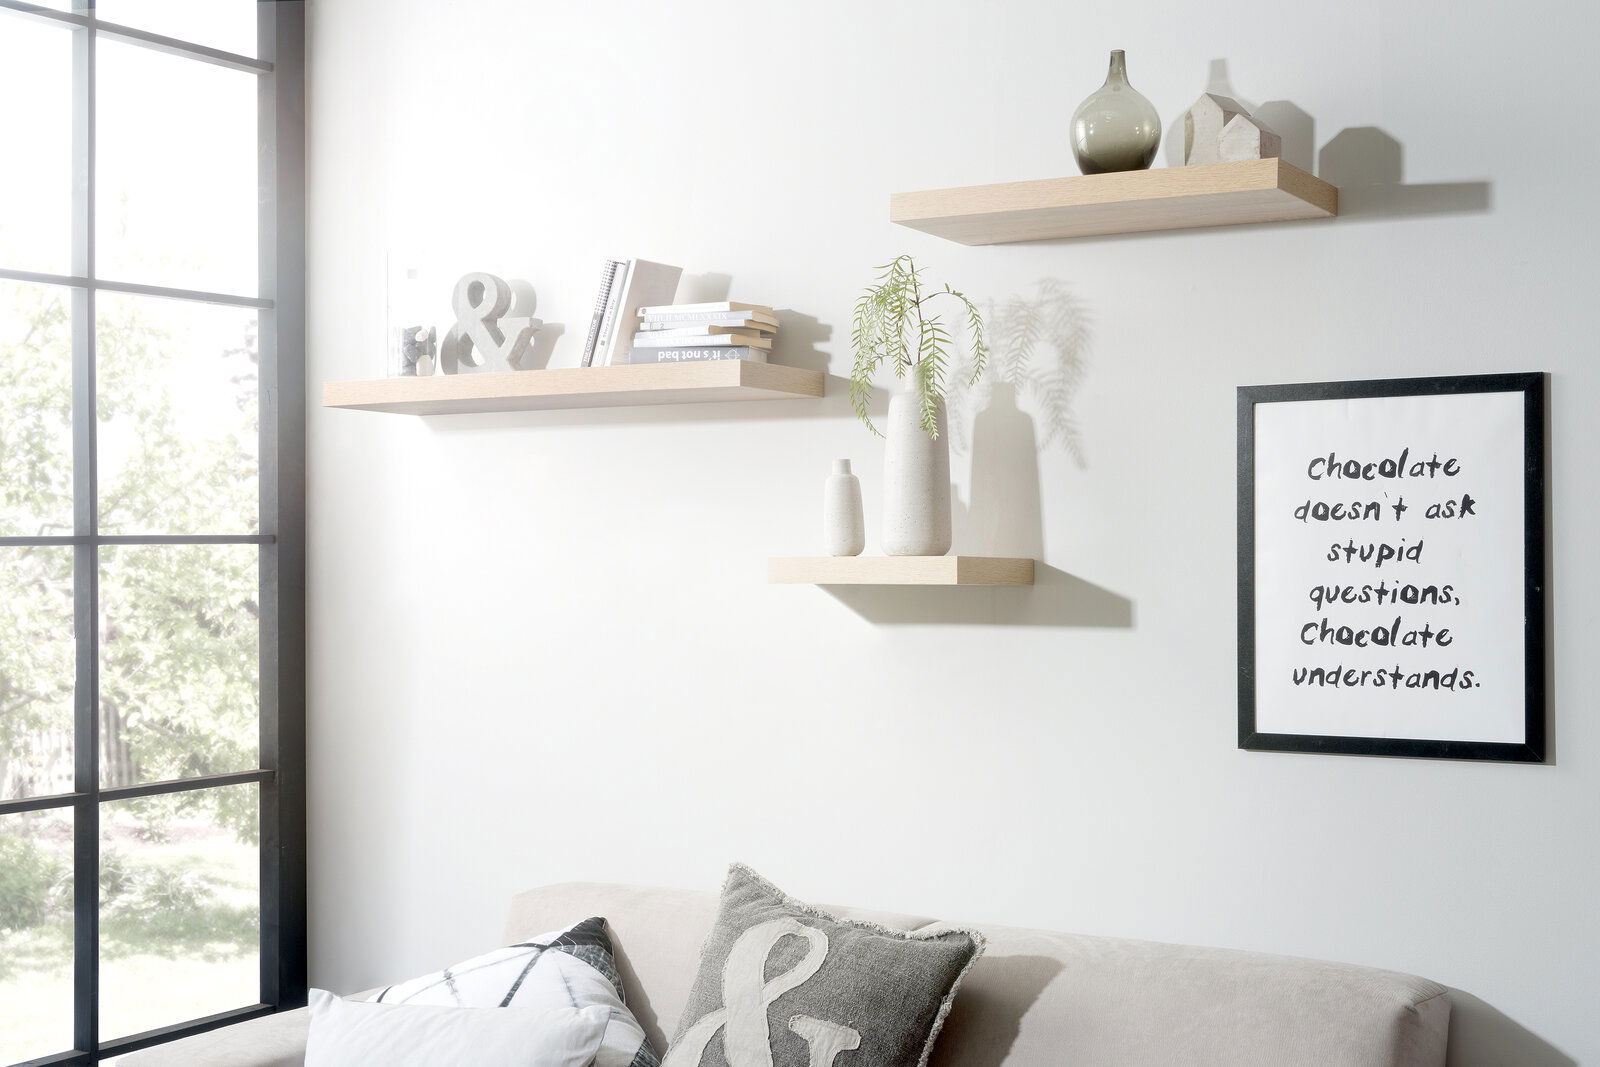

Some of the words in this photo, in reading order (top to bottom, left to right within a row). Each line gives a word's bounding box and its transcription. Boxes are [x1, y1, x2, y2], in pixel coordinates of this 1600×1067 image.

[657, 350, 680, 362] bad
[682, 350, 701, 360] not
[703, 350, 721, 361] it's
[1307, 447, 1461, 481] Chocolate
[1294, 492, 1408, 524] doesn't
[1424, 493, 1476, 520] ask
[1326, 537, 1424, 569] stupid
[1309, 579, 1460, 612] questions,
[1300, 615, 1453, 649] Chocolate
[1292, 663, 1481, 692] understands.
